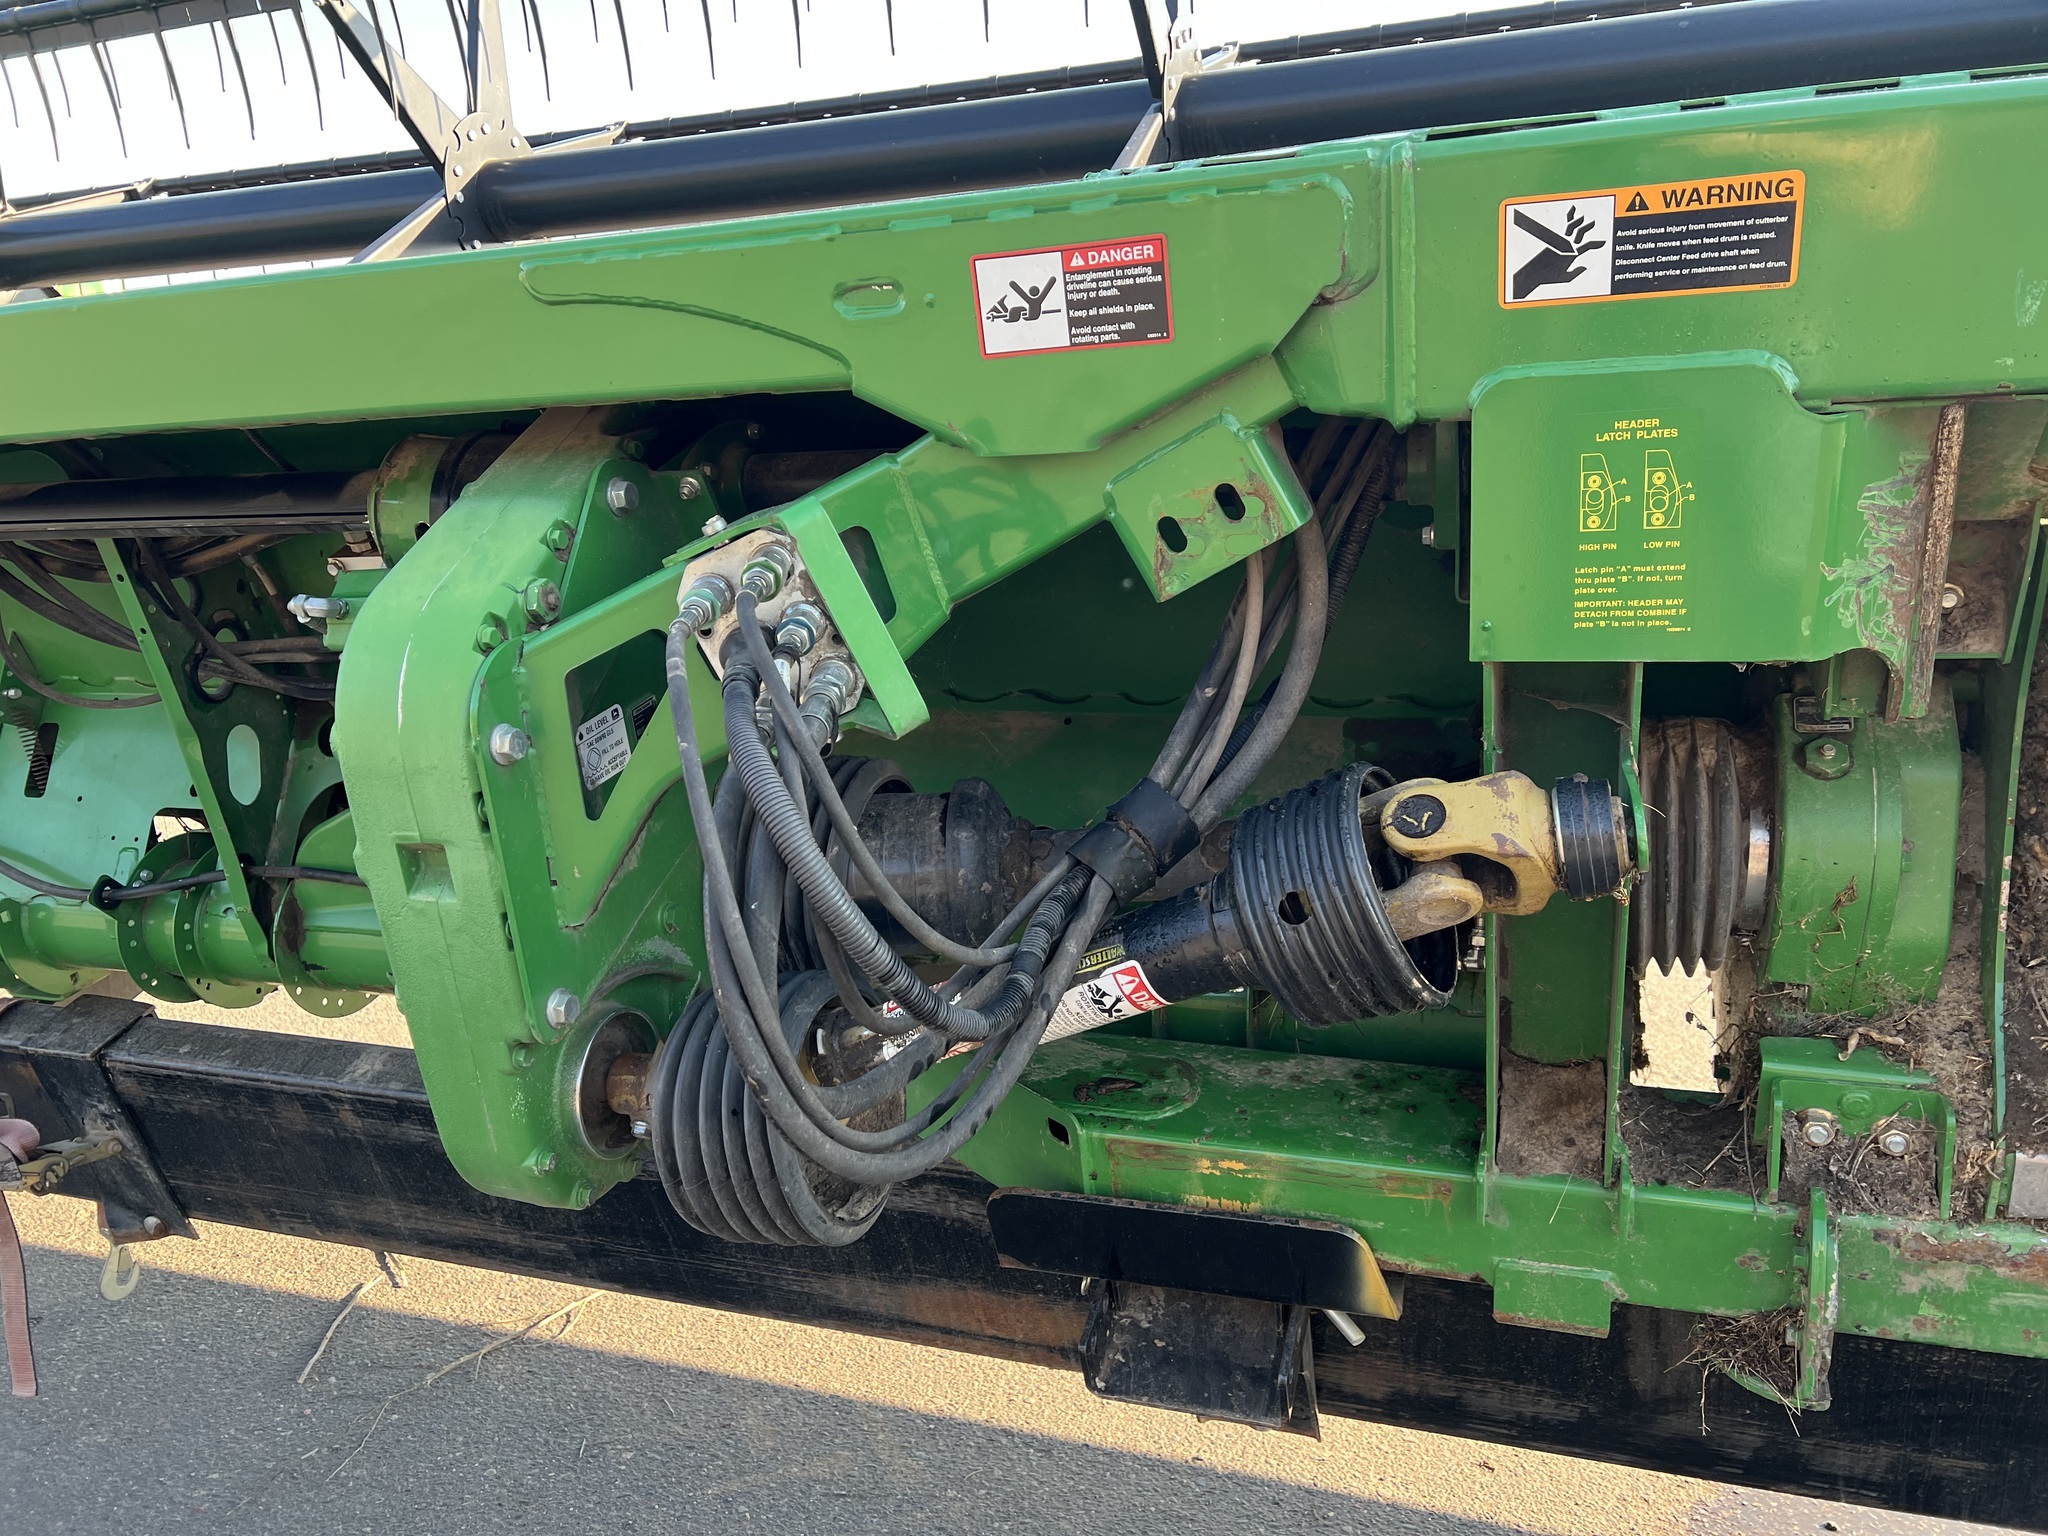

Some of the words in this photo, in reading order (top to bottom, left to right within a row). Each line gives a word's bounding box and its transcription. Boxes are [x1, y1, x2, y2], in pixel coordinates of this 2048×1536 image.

[1661, 178, 1795, 208] WARNING
[1617, 229, 1637, 237] Avoid
[1638, 227, 1665, 235] serious
[1666, 224, 1687, 234] injury
[1689, 222, 1705, 231] from
[1707, 220, 1744, 229] movement
[1746, 218, 1754, 226] of
[1756, 215, 1788, 224] cutterbar
[1616, 243, 1635, 251] knife.
[1637, 240, 1656, 249] Knife
[1657, 239, 1680, 247] moves
[1682, 237, 1701, 246] when
[1703, 236, 1719, 244] feed
[1721, 234, 1739, 243] drum
[1741, 233, 1747, 241] is
[1749, 231, 1776, 240] rotated.
[1088, 245, 1154, 265] DANGER
[1616, 255, 1655, 265] Disconnect
[1656, 253, 1680, 262] Center
[1682, 252, 1699, 260] Feed
[1701, 250, 1719, 258] drive
[1721, 248, 1739, 257] shaft
[1740, 247, 1759, 255] when
[1066, 270, 1114, 281] Entanglement
[1124, 266, 1152, 275] rotating
[1614, 269, 1652, 281] performing
[1654, 268, 1680, 276] service
[1691, 263, 1736, 273] maintenance
[1738, 262, 1747, 270] on
[1749, 260, 1765, 268] feed
[1766, 259, 1787, 268] drum.
[1066, 281, 1097, 290] driveline
[1135, 275, 1162, 283] serious
[1067, 292, 1087, 300] injury
[1099, 289, 1120, 297] death.
[1070, 309, 1087, 318] Keep
[1089, 307, 1097, 315] all
[1099, 305, 1124, 314] shields
[1134, 303, 1155, 312] place.
[1071, 326, 1091, 334] Avoid
[1093, 323, 1118, 332] contact
[1120, 322, 1135, 330] with
[1072, 335, 1099, 344] rotating
[1100, 333, 1120, 342] parts.
[1614, 419, 1660, 429] HEADER
[1596, 431, 1630, 441] LATCH
[1636, 429, 1678, 439] PLATES
[1601, 566, 1614, 574] pin
[1595, 576, 1615, 584] plate
[1574, 587, 1595, 595] plate
[1574, 600, 1625, 608] IMPORTANT:
[1574, 610, 1607, 618] DETACH
[1647, 619, 1672, 627] place.
[586, 724, 594, 735] OIL
[595, 716, 609, 729] LEVEL
[614, 738, 624, 747] HOLE
[1078, 991, 1101, 1018] ROTATING
